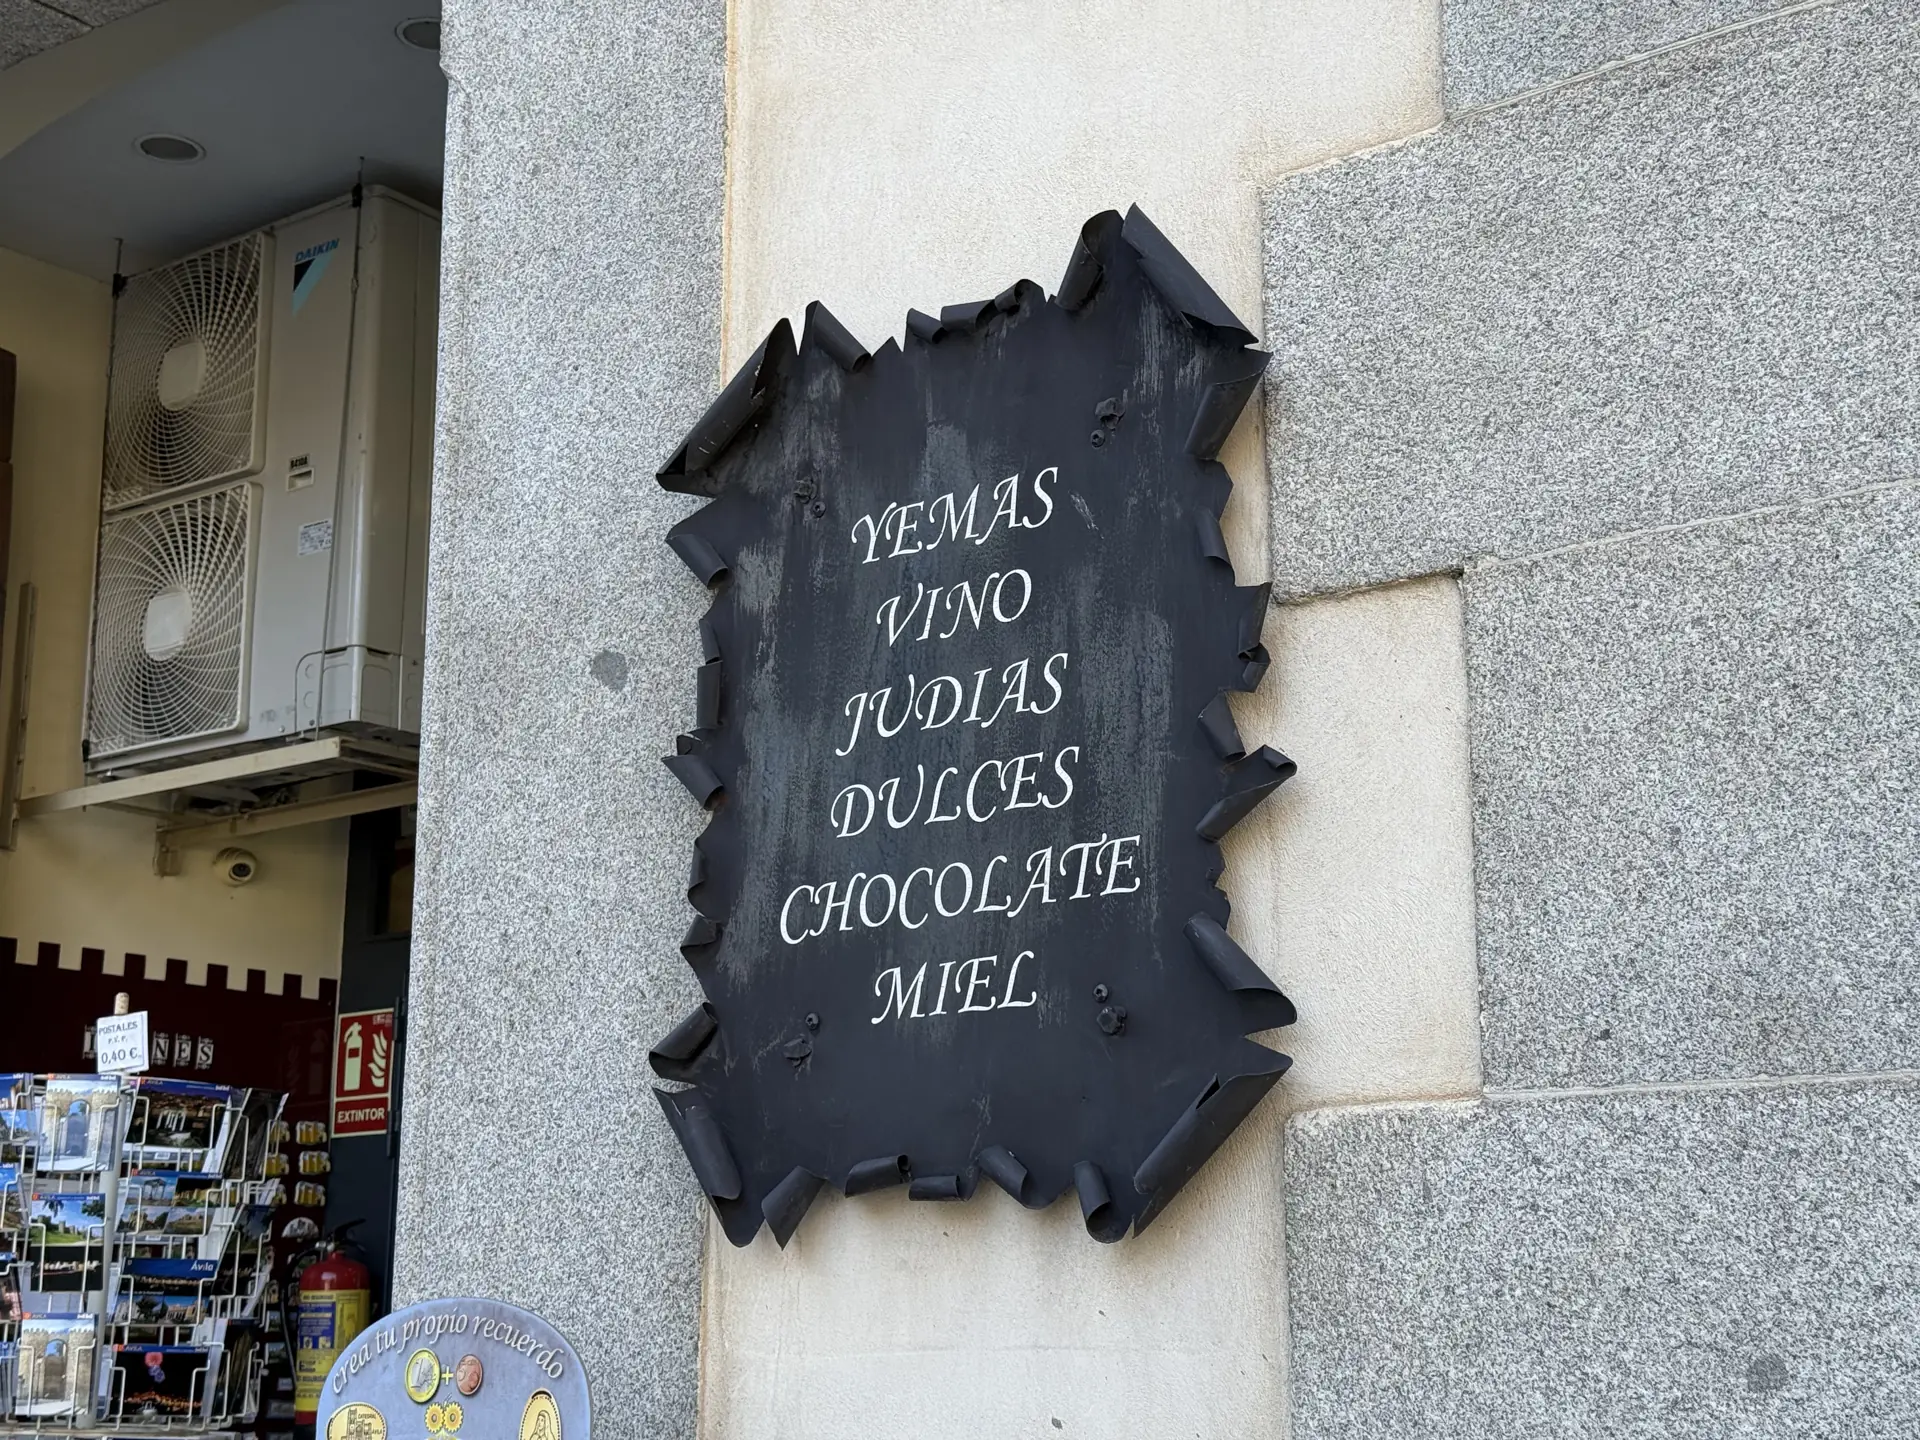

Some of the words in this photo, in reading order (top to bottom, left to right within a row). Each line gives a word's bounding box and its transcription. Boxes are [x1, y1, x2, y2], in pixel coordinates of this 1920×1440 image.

[295, 238, 340, 262] DAIKIN
[852, 467, 1058, 564] YEMAS
[877, 569, 1031, 647] VINO
[836, 653, 1068, 756] JUDIAS
[831, 746, 1079, 838] DULCES
[780, 833, 1141, 944] CHOCOLATE
[871, 950, 1037, 1025] MIEL
[99, 1021, 138, 1036] POSTALES
[101, 1048, 126, 1064] 0,40
[337, 1108, 385, 1123] EXTINTOR
[190, 1260, 214, 1271] Ávila
[333, 1343, 372, 1394] crea
[375, 1327, 398, 1354] tu
[397, 1306, 468, 1355] propio
[472, 1315, 564, 1378] recuerdo
